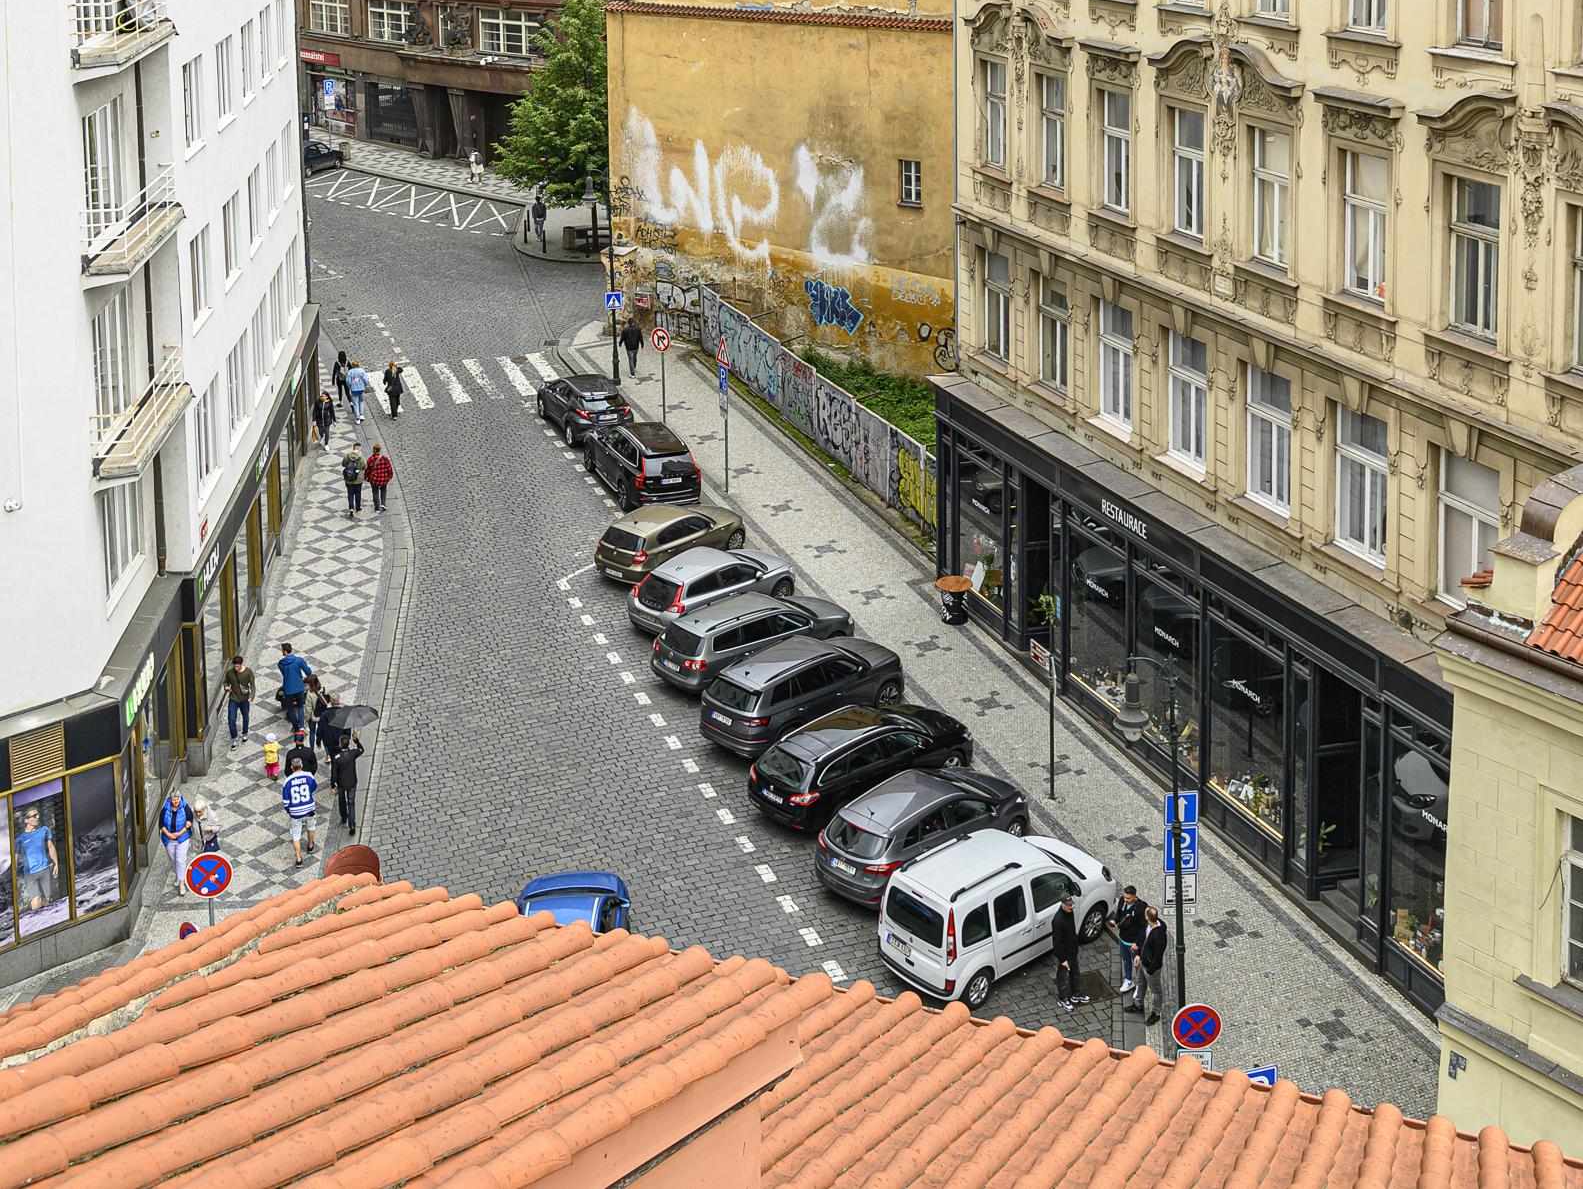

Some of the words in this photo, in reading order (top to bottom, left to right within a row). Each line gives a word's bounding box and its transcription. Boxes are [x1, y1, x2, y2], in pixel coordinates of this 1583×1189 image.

[1101, 498, 1148, 540] RESTAURACE
[203, 542, 220, 591] HUDY
[1086, 578, 1109, 599] MONARCH
[1154, 625, 1180, 648] MONARCH
[1232, 678, 1261, 704] MONARCH
[290, 783, 311, 805] 69
